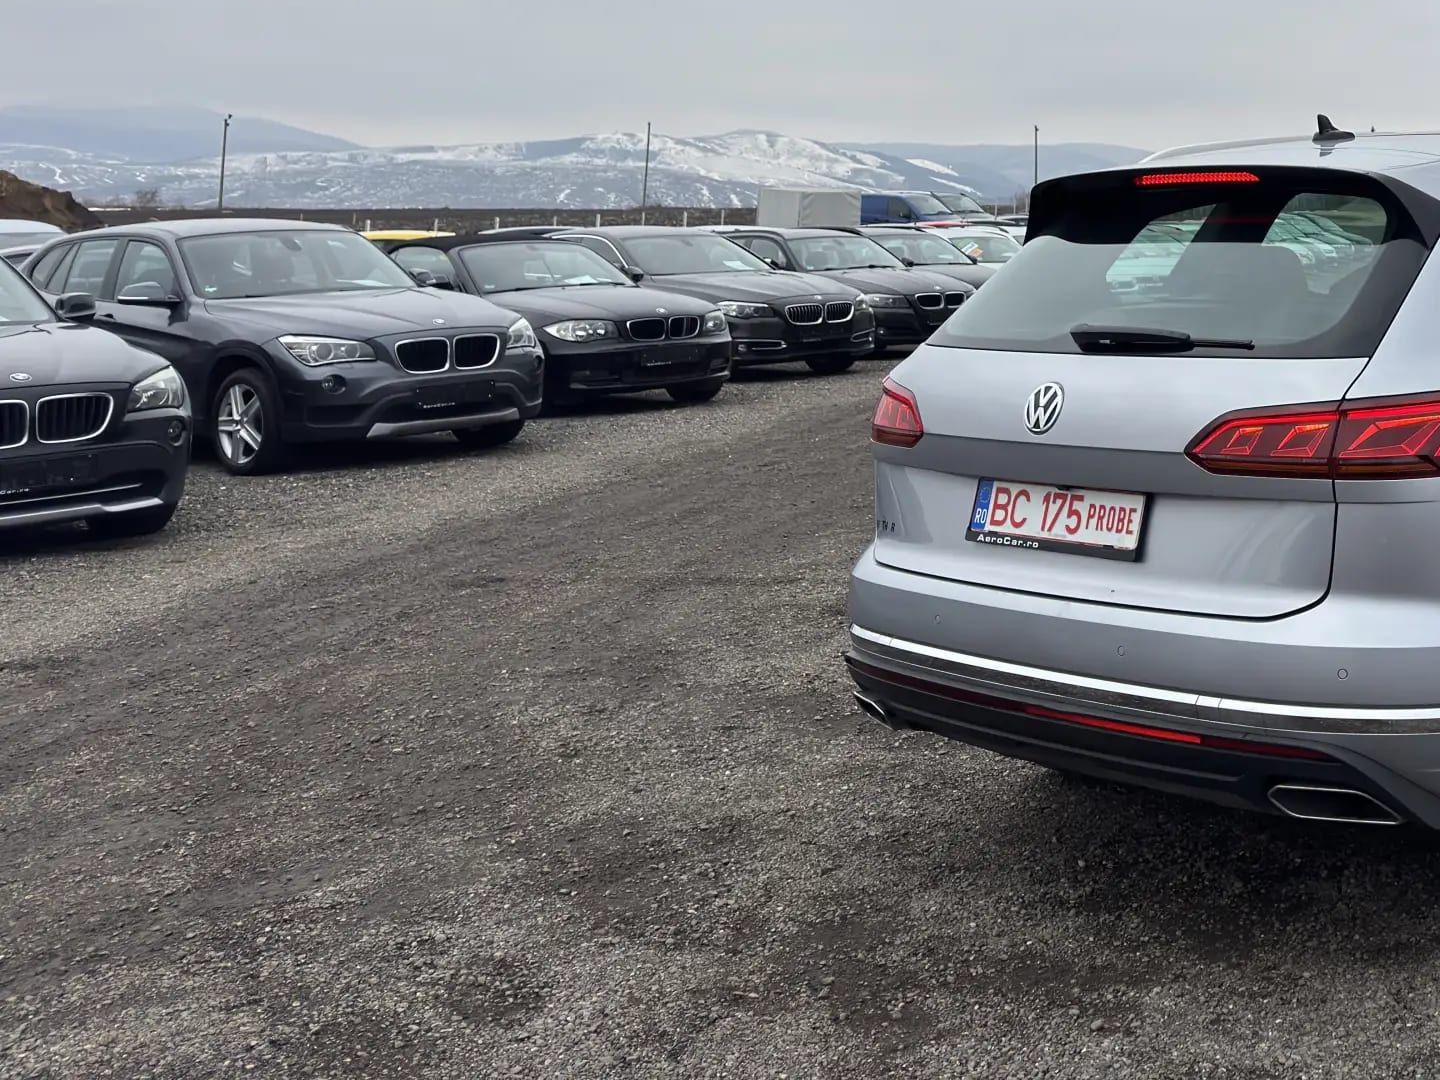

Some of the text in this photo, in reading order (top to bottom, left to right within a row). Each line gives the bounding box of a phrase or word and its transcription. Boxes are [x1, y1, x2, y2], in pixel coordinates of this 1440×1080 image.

[1024, 381, 1065, 435] VW
[974, 507, 988, 525] RO
[989, 486, 1137, 535] BC 175 PROBE
[976, 533, 1039, 549] AeroCar.ro
